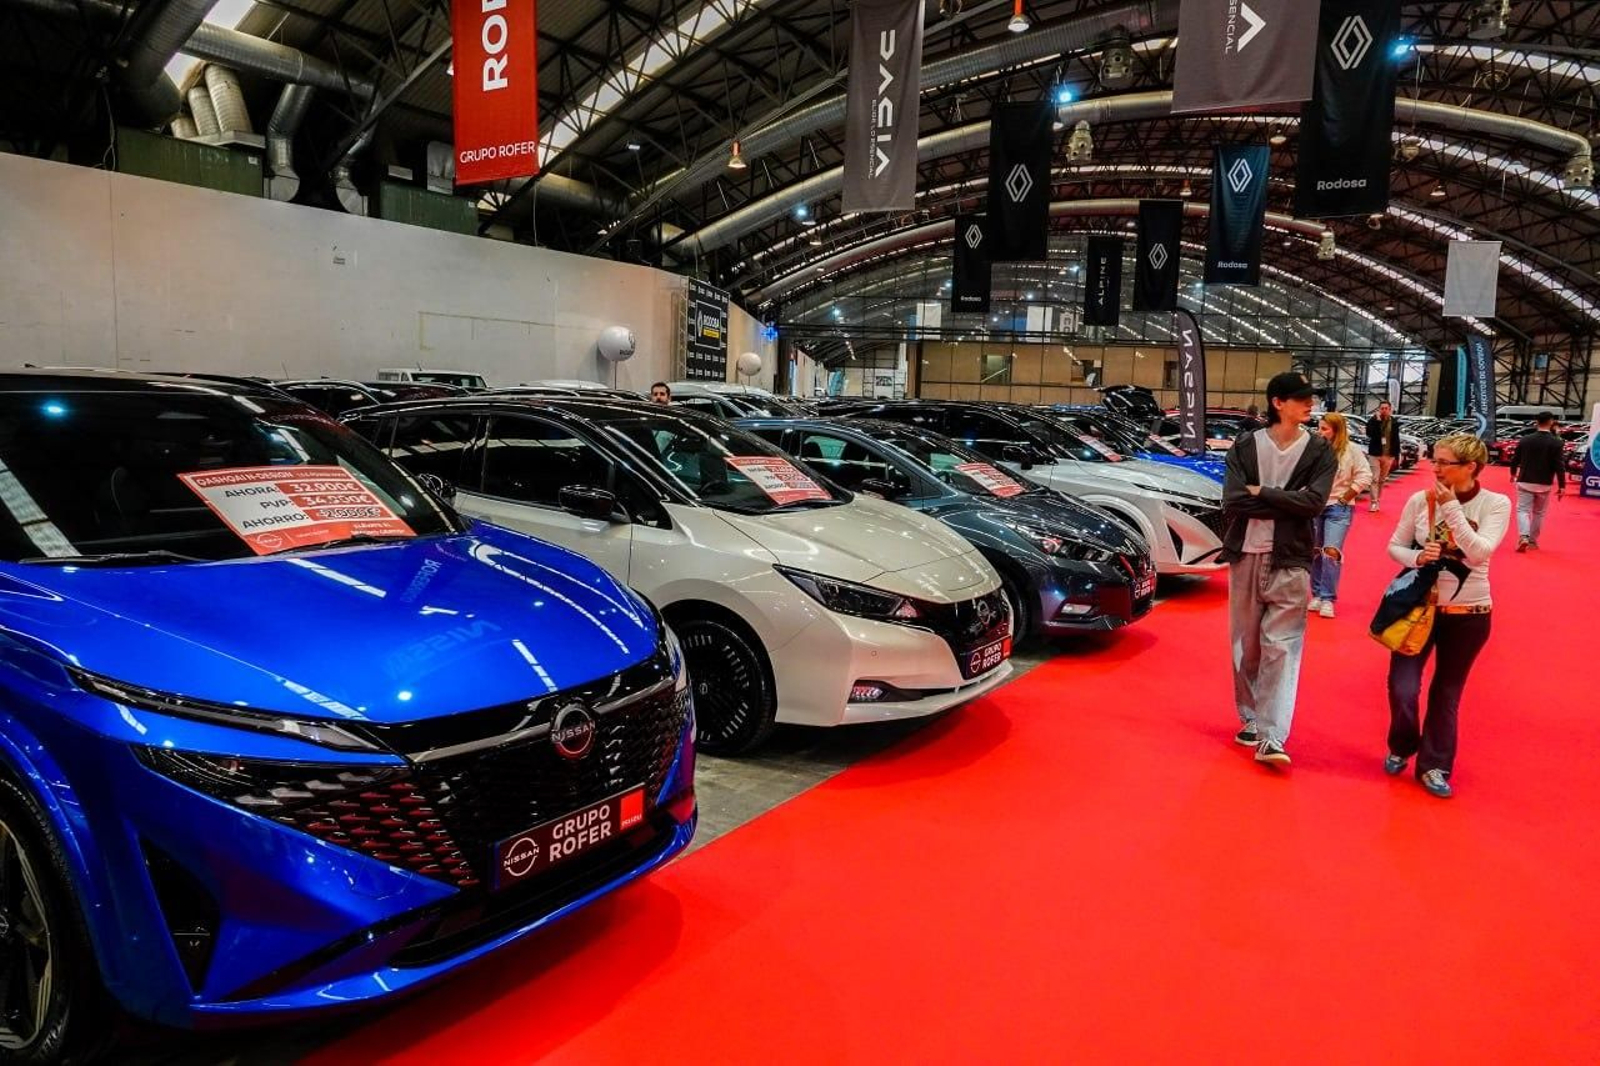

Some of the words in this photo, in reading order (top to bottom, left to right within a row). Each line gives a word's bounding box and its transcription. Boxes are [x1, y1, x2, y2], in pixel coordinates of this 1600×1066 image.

[875, 29, 896, 177] DACIA
[459, 147, 497, 163] GRUPO
[499, 141, 536, 158] ROFER
[1317, 178, 1367, 191] Rodosa
[1217, 260, 1248, 270] Rodosa
[1098, 256, 1107, 306] ALPINE
[225, 486, 280, 498] AHORA:
[260, 499, 295, 509] PVP:
[242, 512, 309, 529] AHORRO:
[551, 719, 596, 741] NISSAN
[552, 804, 611, 840] GRUPO
[549, 820, 612, 862] ROFER
[503, 846, 540, 868] NISSAN
